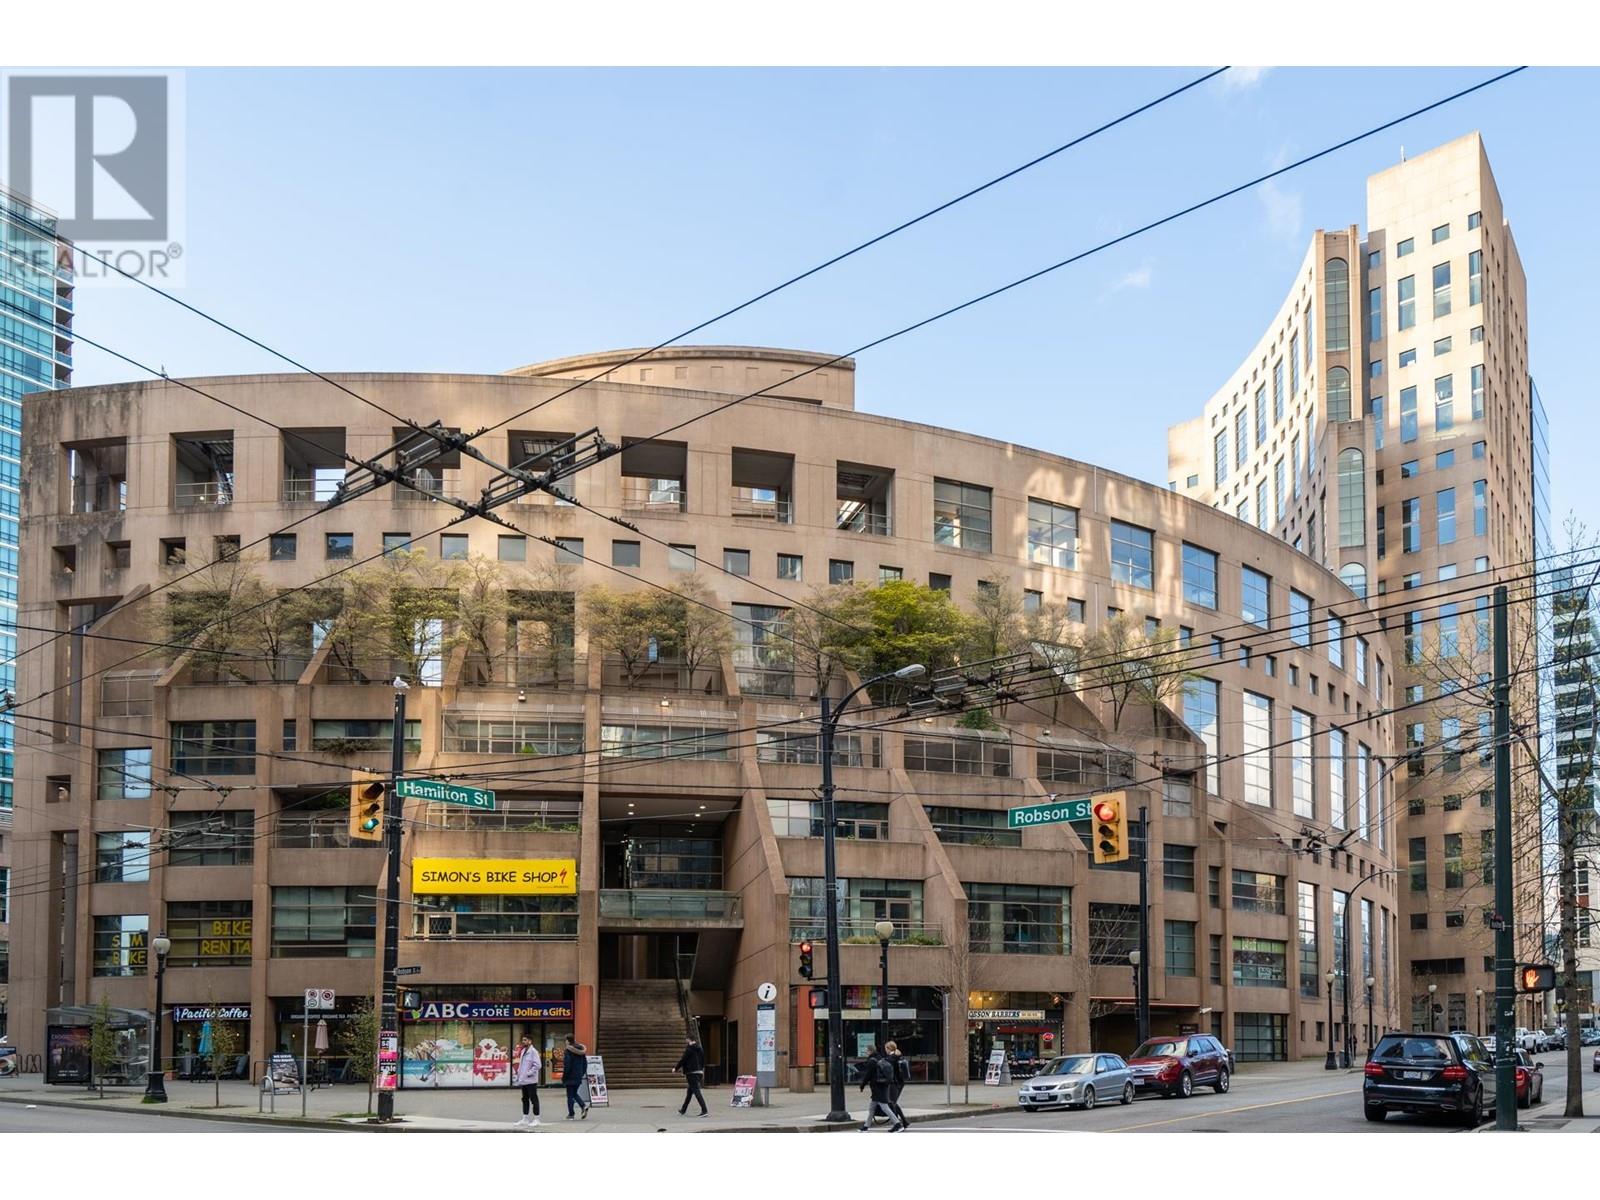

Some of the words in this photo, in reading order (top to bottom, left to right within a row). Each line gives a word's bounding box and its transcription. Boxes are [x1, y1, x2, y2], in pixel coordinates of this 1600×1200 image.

[403, 781, 468, 803] Hamilton
[474, 791, 489, 806] St
[1015, 808, 1070, 824] Robson
[1076, 803, 1092, 817] St
[421, 871, 481, 882] SIMON'S
[486, 871, 517, 883] BIKE
[522, 872, 558, 883] SHOP
[212, 920, 250, 936] BIKE
[181, 1008, 216, 1018] Pacific
[219, 1007, 249, 1018] Coffee
[424, 1003, 469, 1018] ABC
[472, 1008, 510, 1017] STORE
[991, 1010, 1020, 1018] BARBERS
